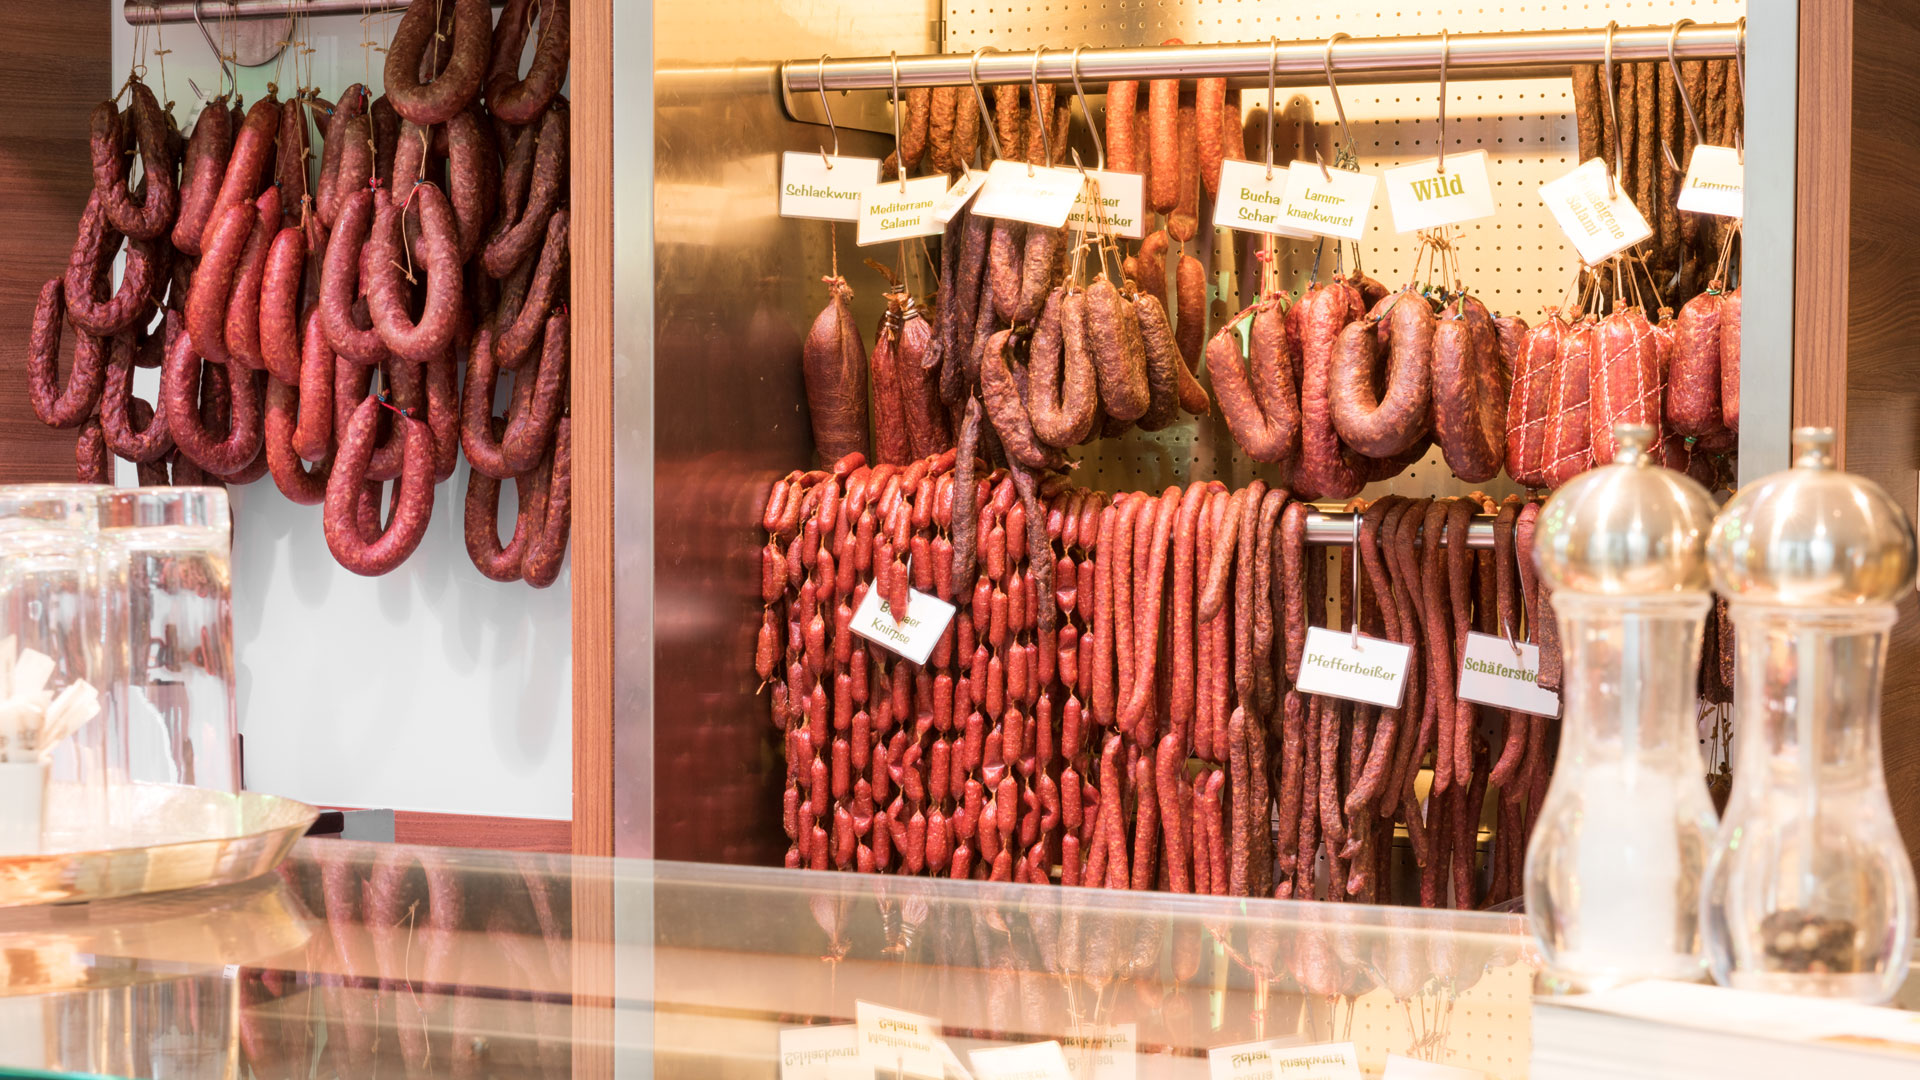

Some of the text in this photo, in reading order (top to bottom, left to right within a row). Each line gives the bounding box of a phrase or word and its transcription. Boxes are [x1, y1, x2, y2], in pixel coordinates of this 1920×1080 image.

[1304, 187, 1346, 206] Lamm-
[1410, 173, 1465, 203] Wild
[869, 198, 934, 216] Mediterrane
[1286, 204, 1354, 228] knackwurst
[879, 215, 921, 231] Salami
[871, 617, 911, 645] Knirpse
[1307, 652, 1398, 682] Pfefferbeißer
